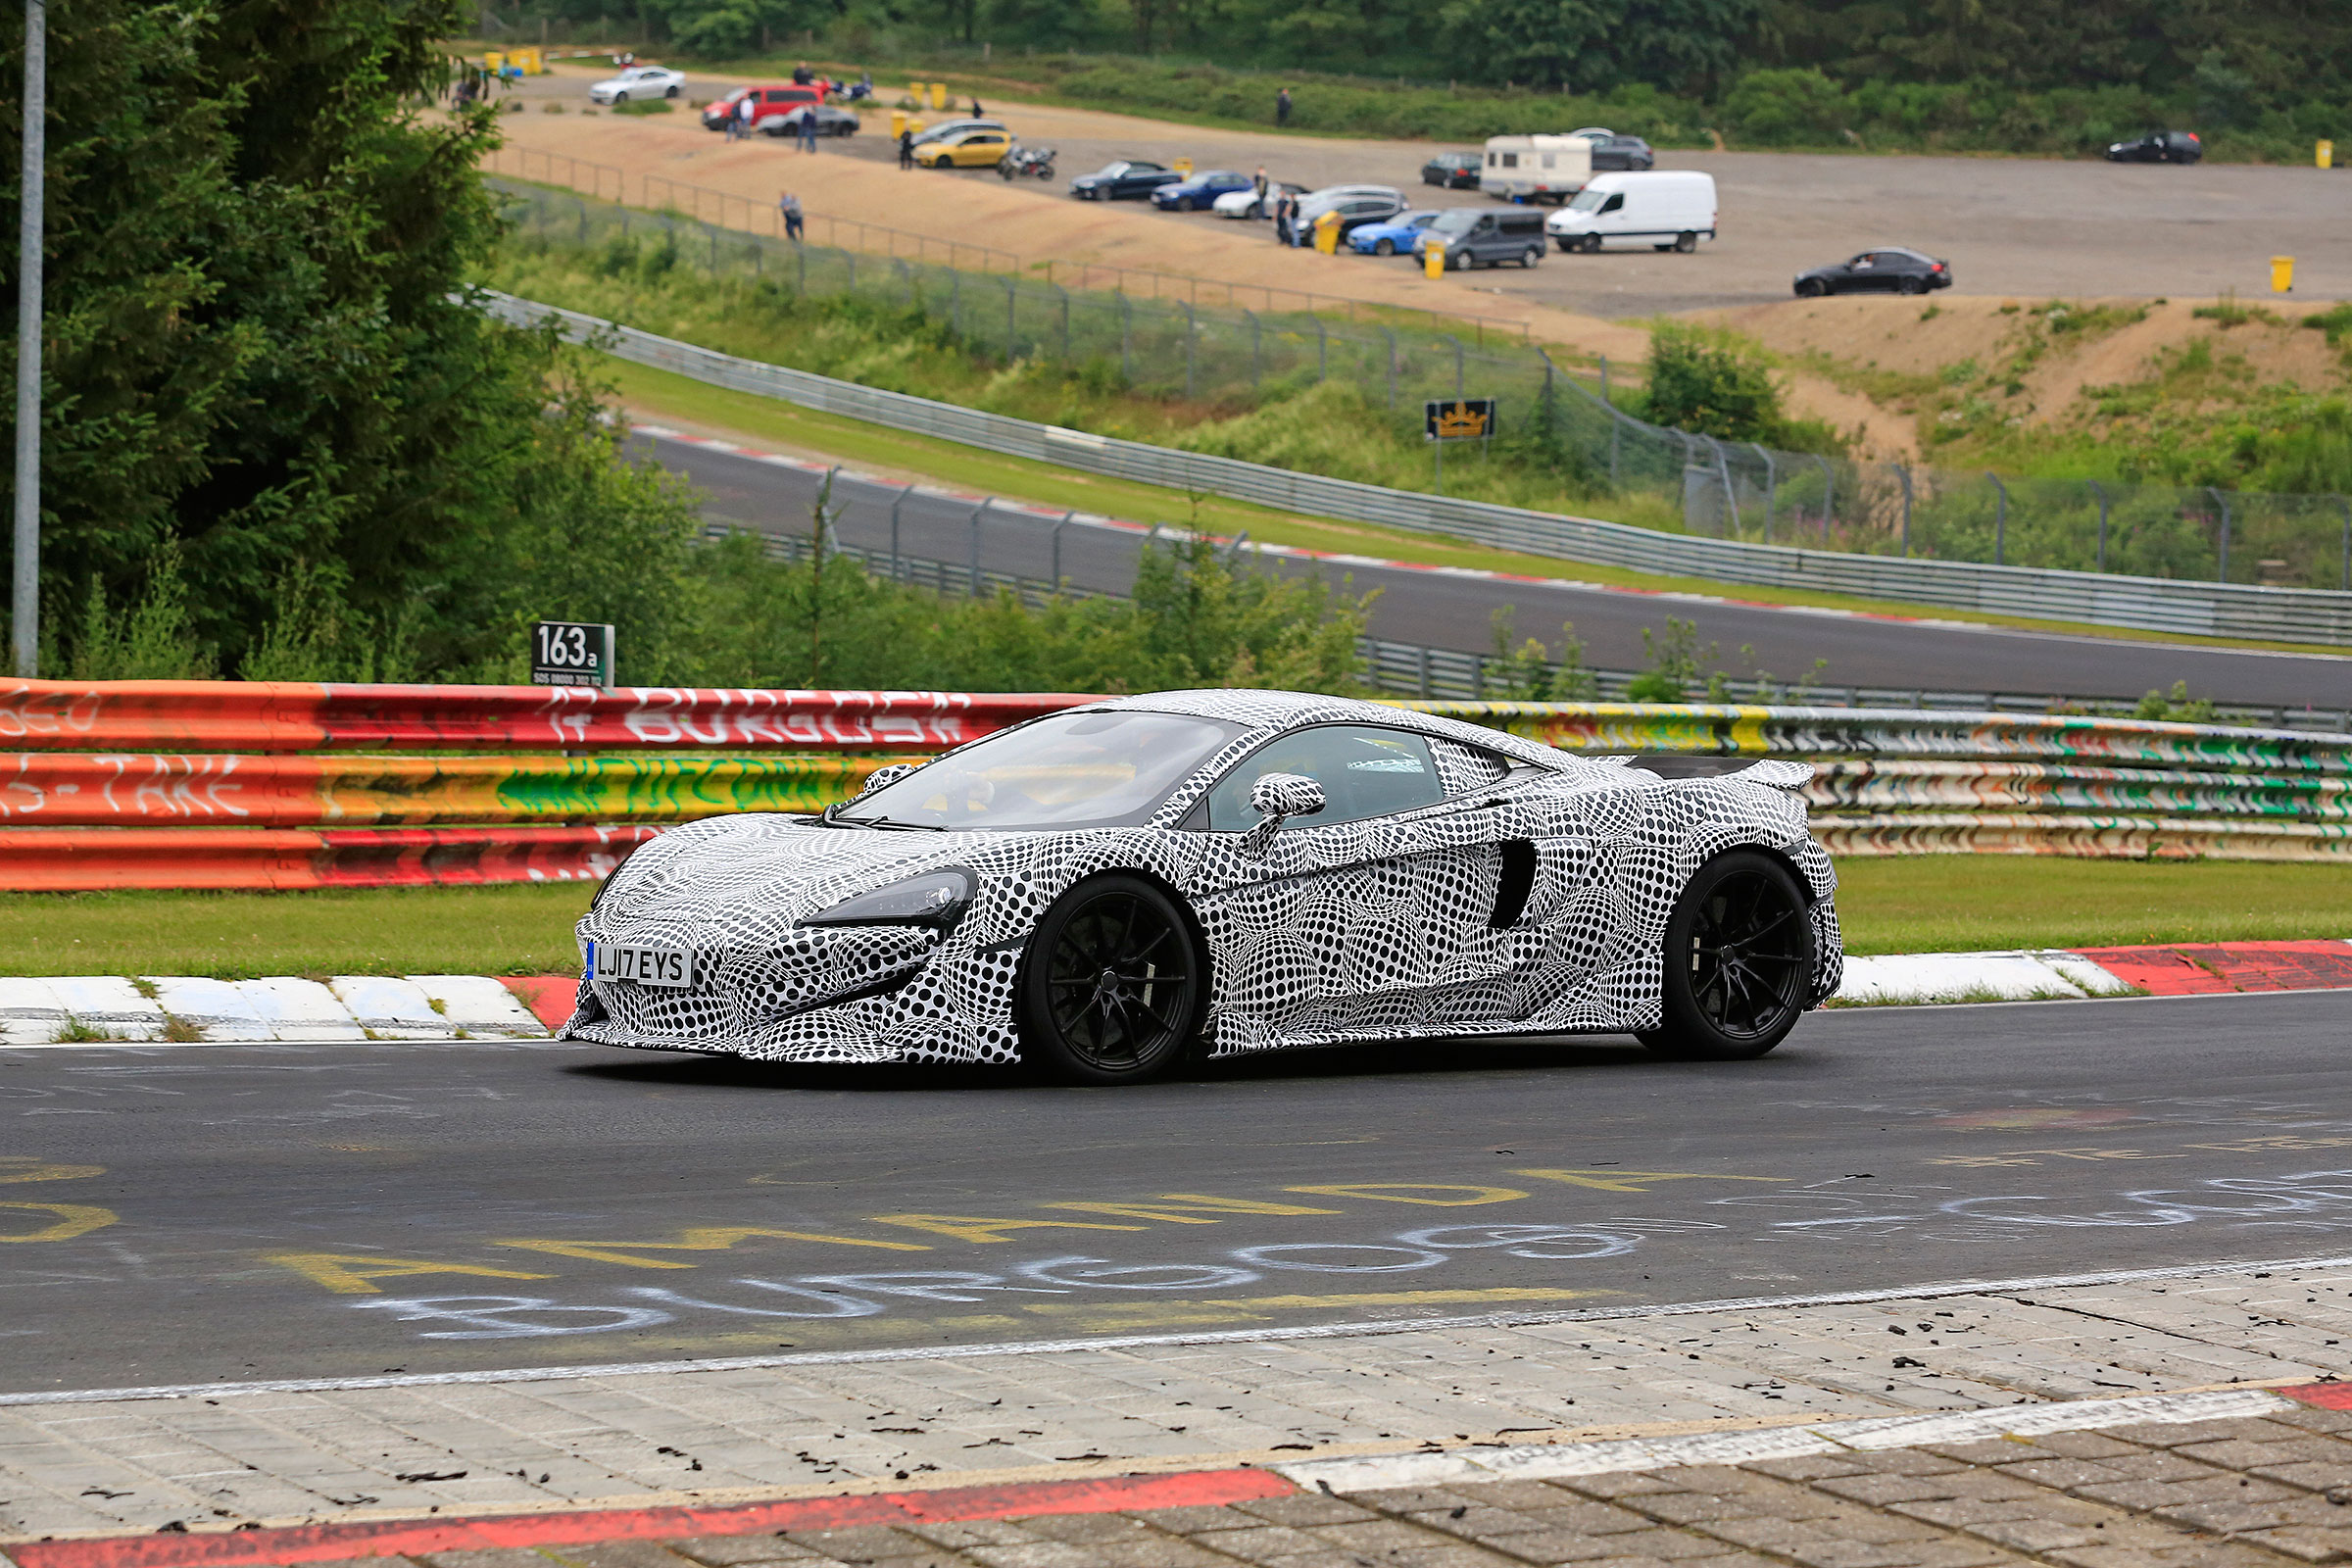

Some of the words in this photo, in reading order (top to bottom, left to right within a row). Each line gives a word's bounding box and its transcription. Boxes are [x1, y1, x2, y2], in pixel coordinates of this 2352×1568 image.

[598, 947, 634, 977] LJ17
[639, 951, 683, 981] EYS
[257, 1168, 1797, 1295] AMANDA
[347, 1224, 1641, 1341] BURGOS
